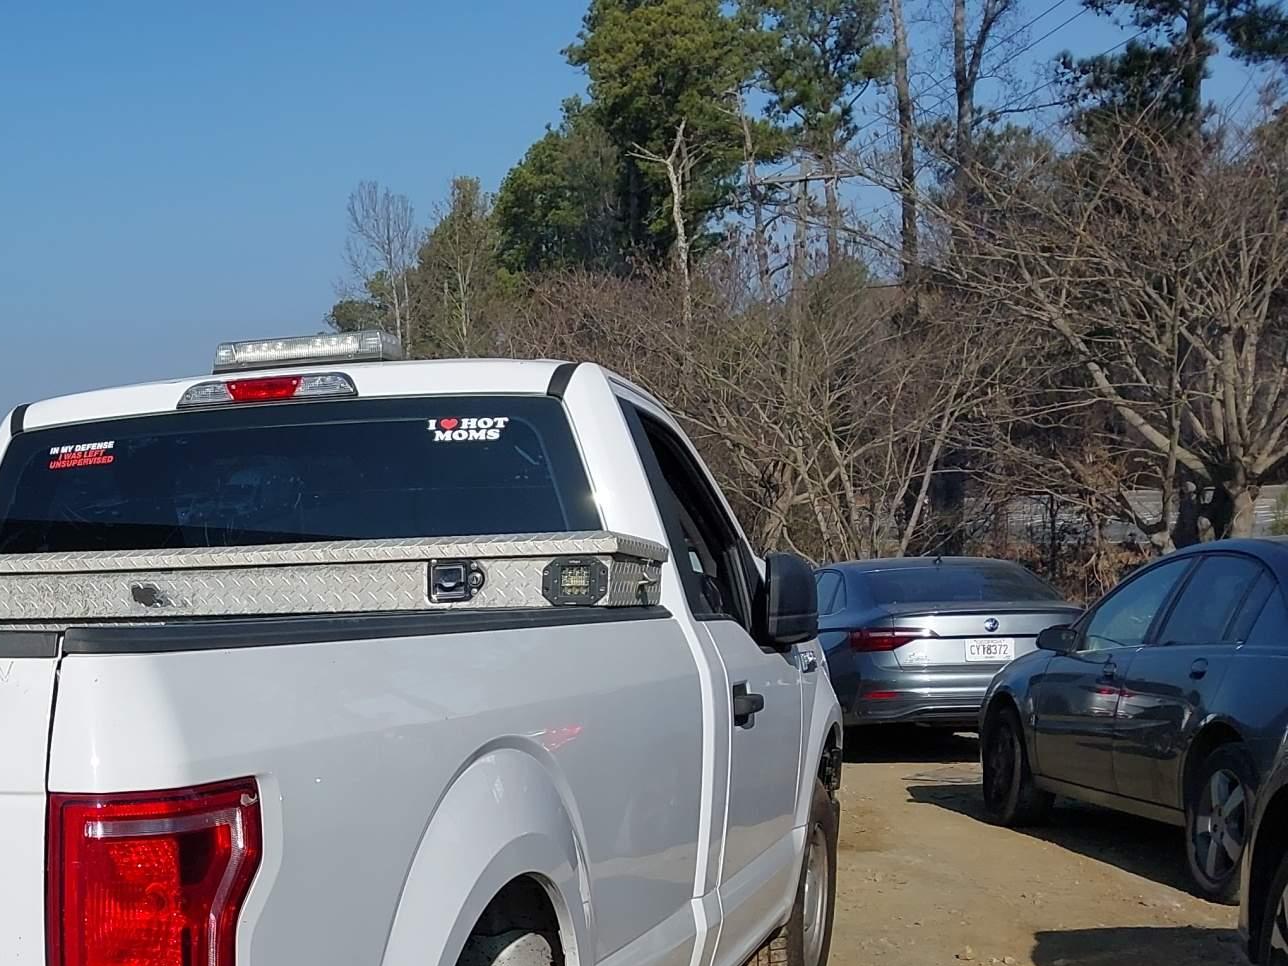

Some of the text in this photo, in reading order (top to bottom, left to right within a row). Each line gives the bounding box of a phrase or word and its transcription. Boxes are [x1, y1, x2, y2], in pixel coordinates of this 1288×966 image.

[427, 417, 509, 430] I HOT
[433, 429, 501, 441] MOMS
[50, 441, 115, 455] IN MY DEFENSE
[63, 452, 82, 461] WAS
[83, 450, 106, 459] LEFT
[49, 456, 114, 469] UNSUPERVISED
